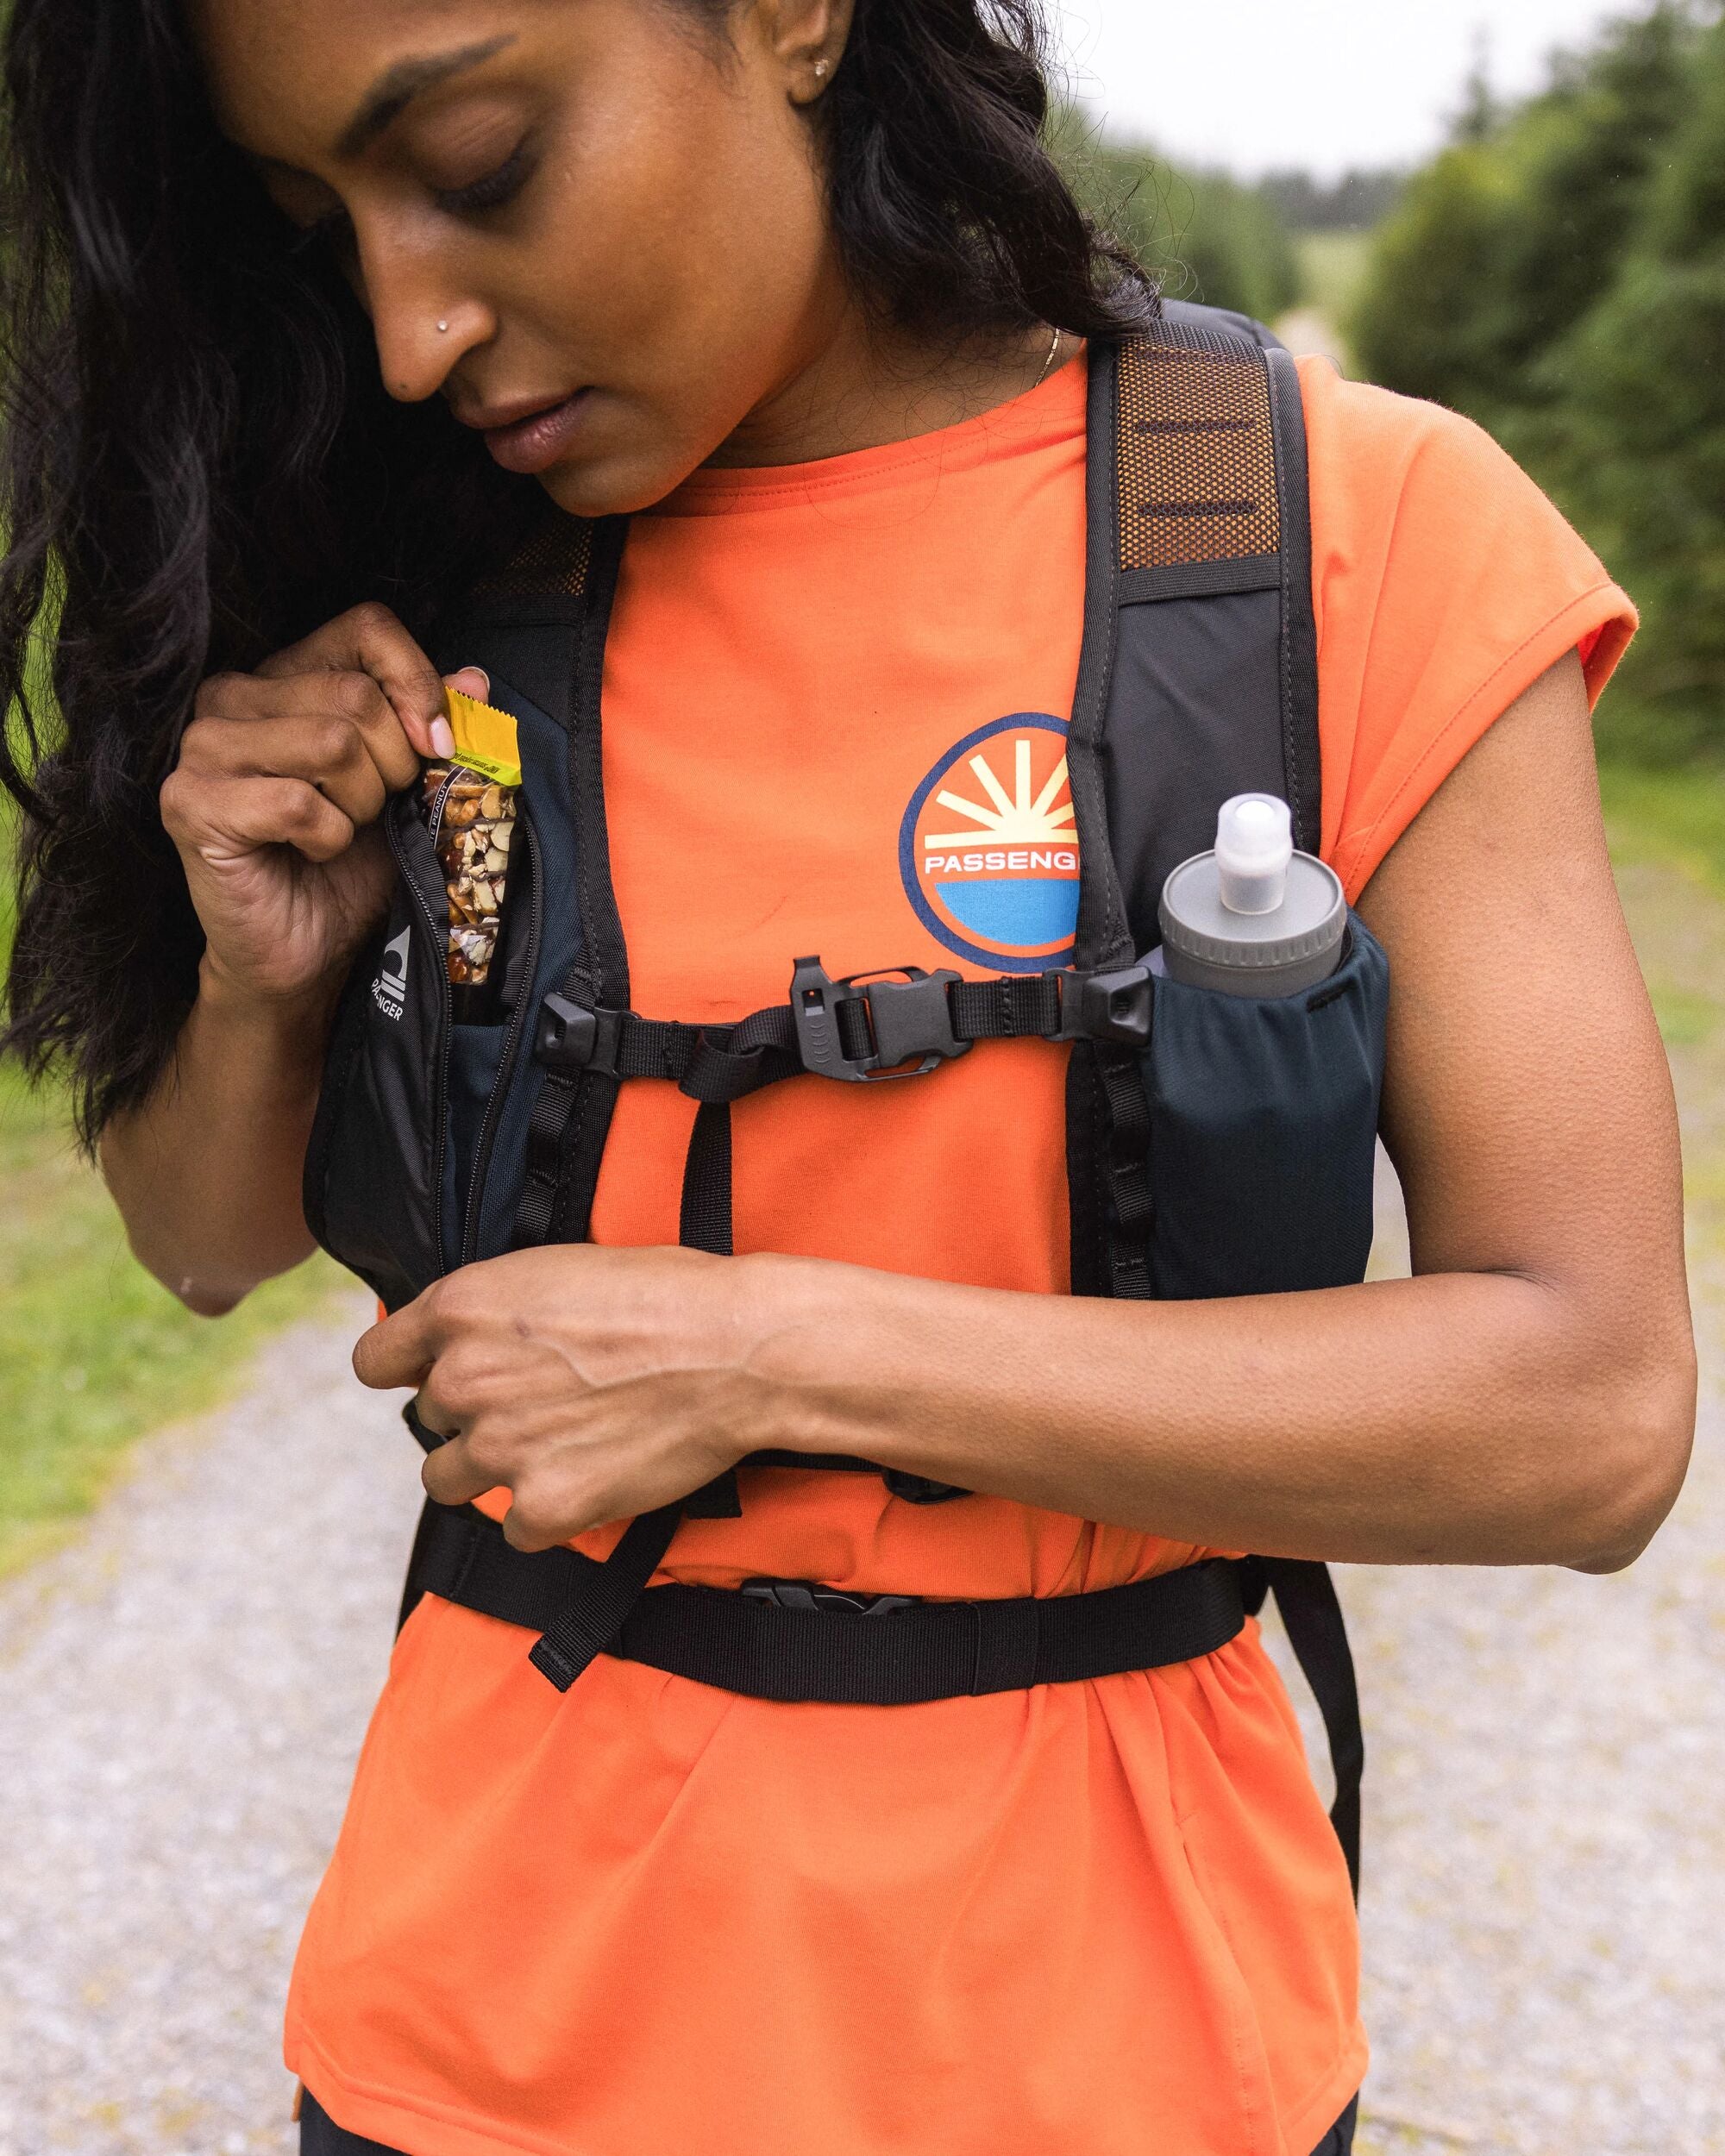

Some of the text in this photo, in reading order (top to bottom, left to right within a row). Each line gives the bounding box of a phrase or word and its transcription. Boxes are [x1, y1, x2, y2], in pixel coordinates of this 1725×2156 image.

[431, 784, 448, 825] PEANUT
[925, 851, 1080, 874] PASSENG
[371, 978, 403, 1021] PANGER
